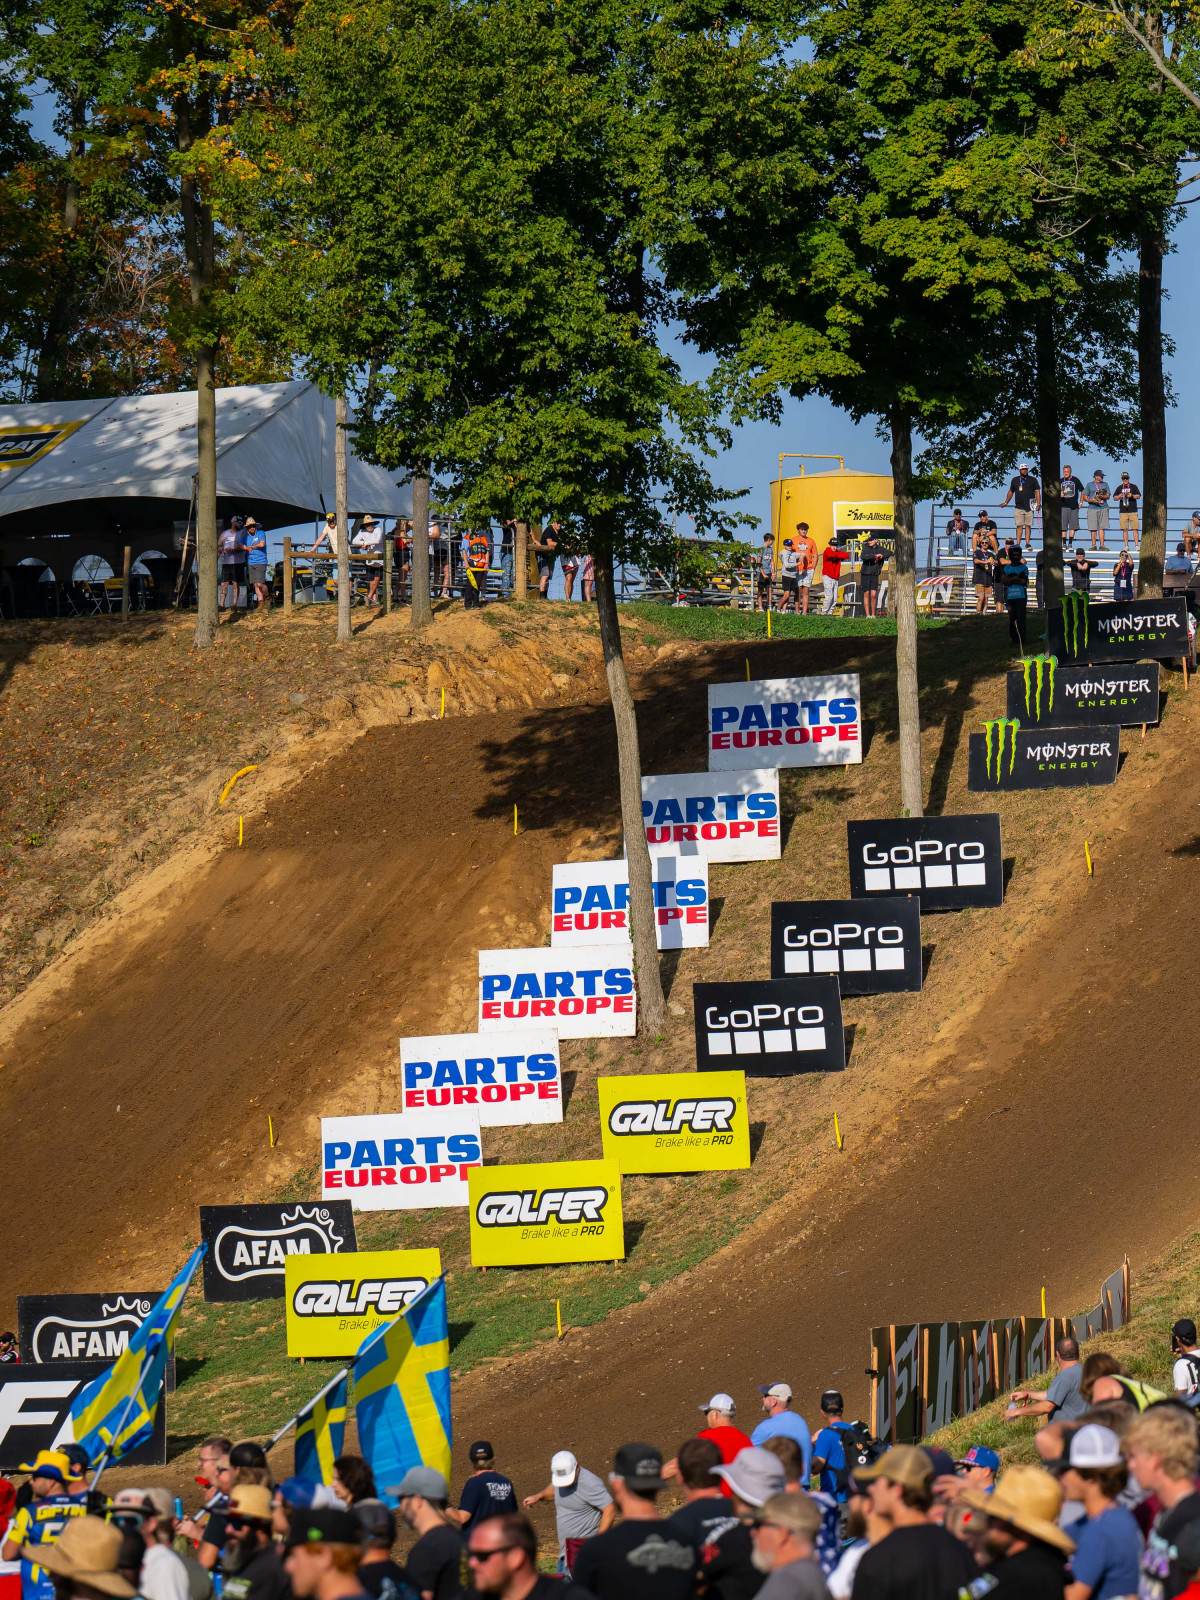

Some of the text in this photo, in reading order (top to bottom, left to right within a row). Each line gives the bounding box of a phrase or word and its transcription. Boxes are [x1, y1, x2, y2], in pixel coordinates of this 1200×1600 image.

[1098, 613, 1181, 634] MONSTER
[1109, 632, 1167, 643] ENERGY
[1065, 678, 1151, 698] MONSTER
[711, 697, 858, 732] PARTS
[1078, 697, 1139, 708] ENERGY
[711, 724, 858, 750] EUROPE
[1026, 742, 1112, 761] MONSTER
[1038, 761, 1098, 771] ENERGY
[645, 819, 779, 844] UROPE
[862, 840, 985, 865] GoPro
[554, 906, 708, 932] EURPE
[783, 923, 904, 948] GoPro
[481, 967, 634, 1002] PARTS
[481, 995, 634, 1020] EUROPE
[705, 1004, 824, 1029] GoPro
[404, 1053, 558, 1089] PARTS
[404, 1081, 559, 1108] EUROPE
[609, 1097, 736, 1136] GALFER
[324, 1134, 481, 1170] PARTS
[655, 1135, 733, 1148] Brake like a PRO
[476, 1185, 609, 1228] GALFER
[521, 1228, 550, 1240] Brake
[551, 1227, 570, 1238] like
[580, 1225, 605, 1236] PRO
[232, 1238, 311, 1266] AFAM
[339, 1318, 384, 1330] Brake lik
[51, 1330, 130, 1358] AFAM
[36, 1506, 87, 1521] GIFTIN
